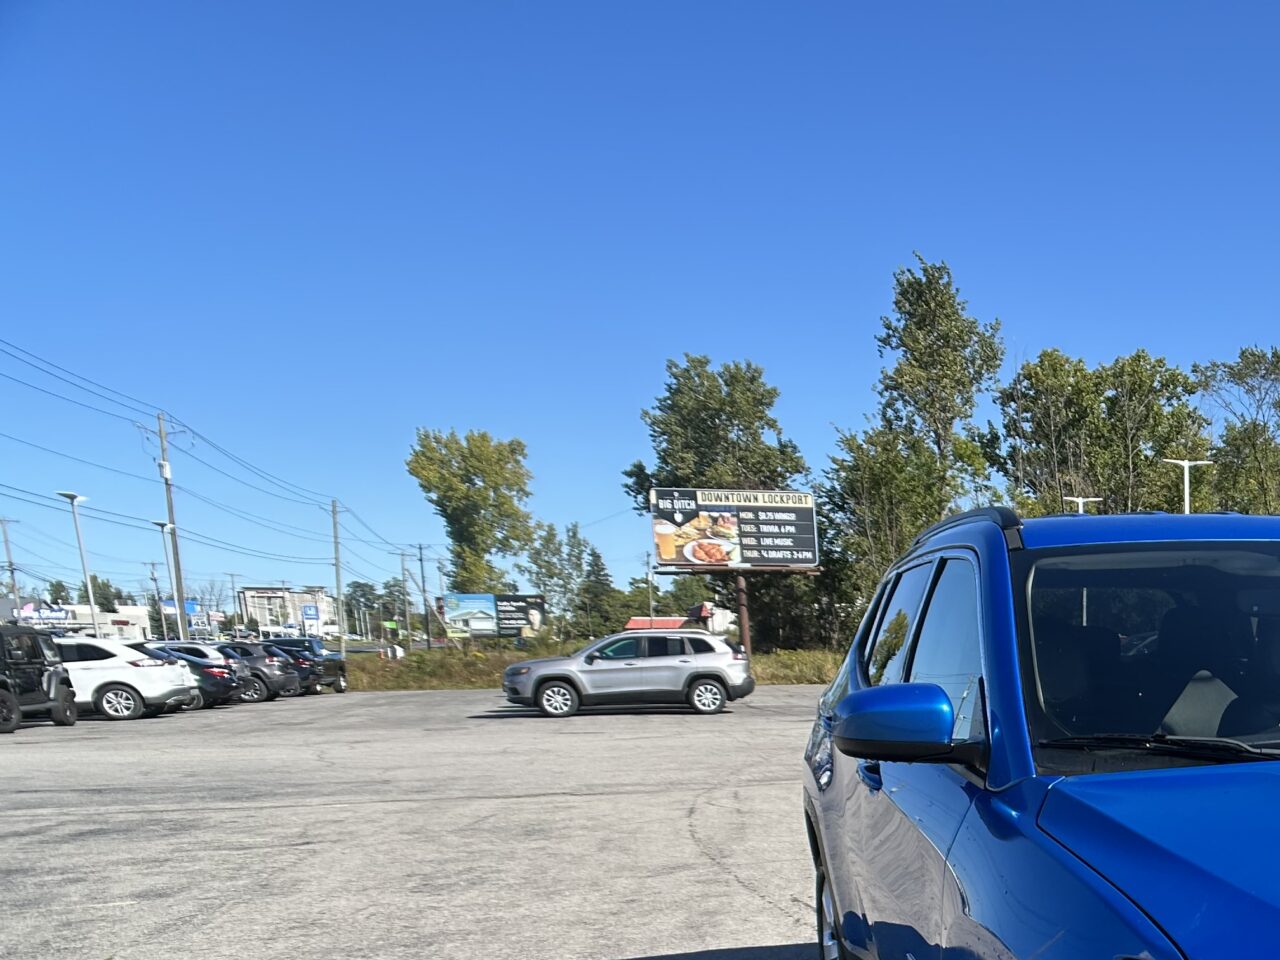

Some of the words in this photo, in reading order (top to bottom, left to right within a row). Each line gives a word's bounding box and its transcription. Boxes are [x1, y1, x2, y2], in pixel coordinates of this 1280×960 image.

[701, 491, 760, 504] DOWNTOWN
[762, 493, 809, 505] LOCKPORT
[658, 499, 674, 509] BIG
[673, 499, 697, 510] DITCH
[760, 537, 774, 546] LIVE
[774, 537, 794, 546] MUSIC
[193, 620, 207, 628] 45
